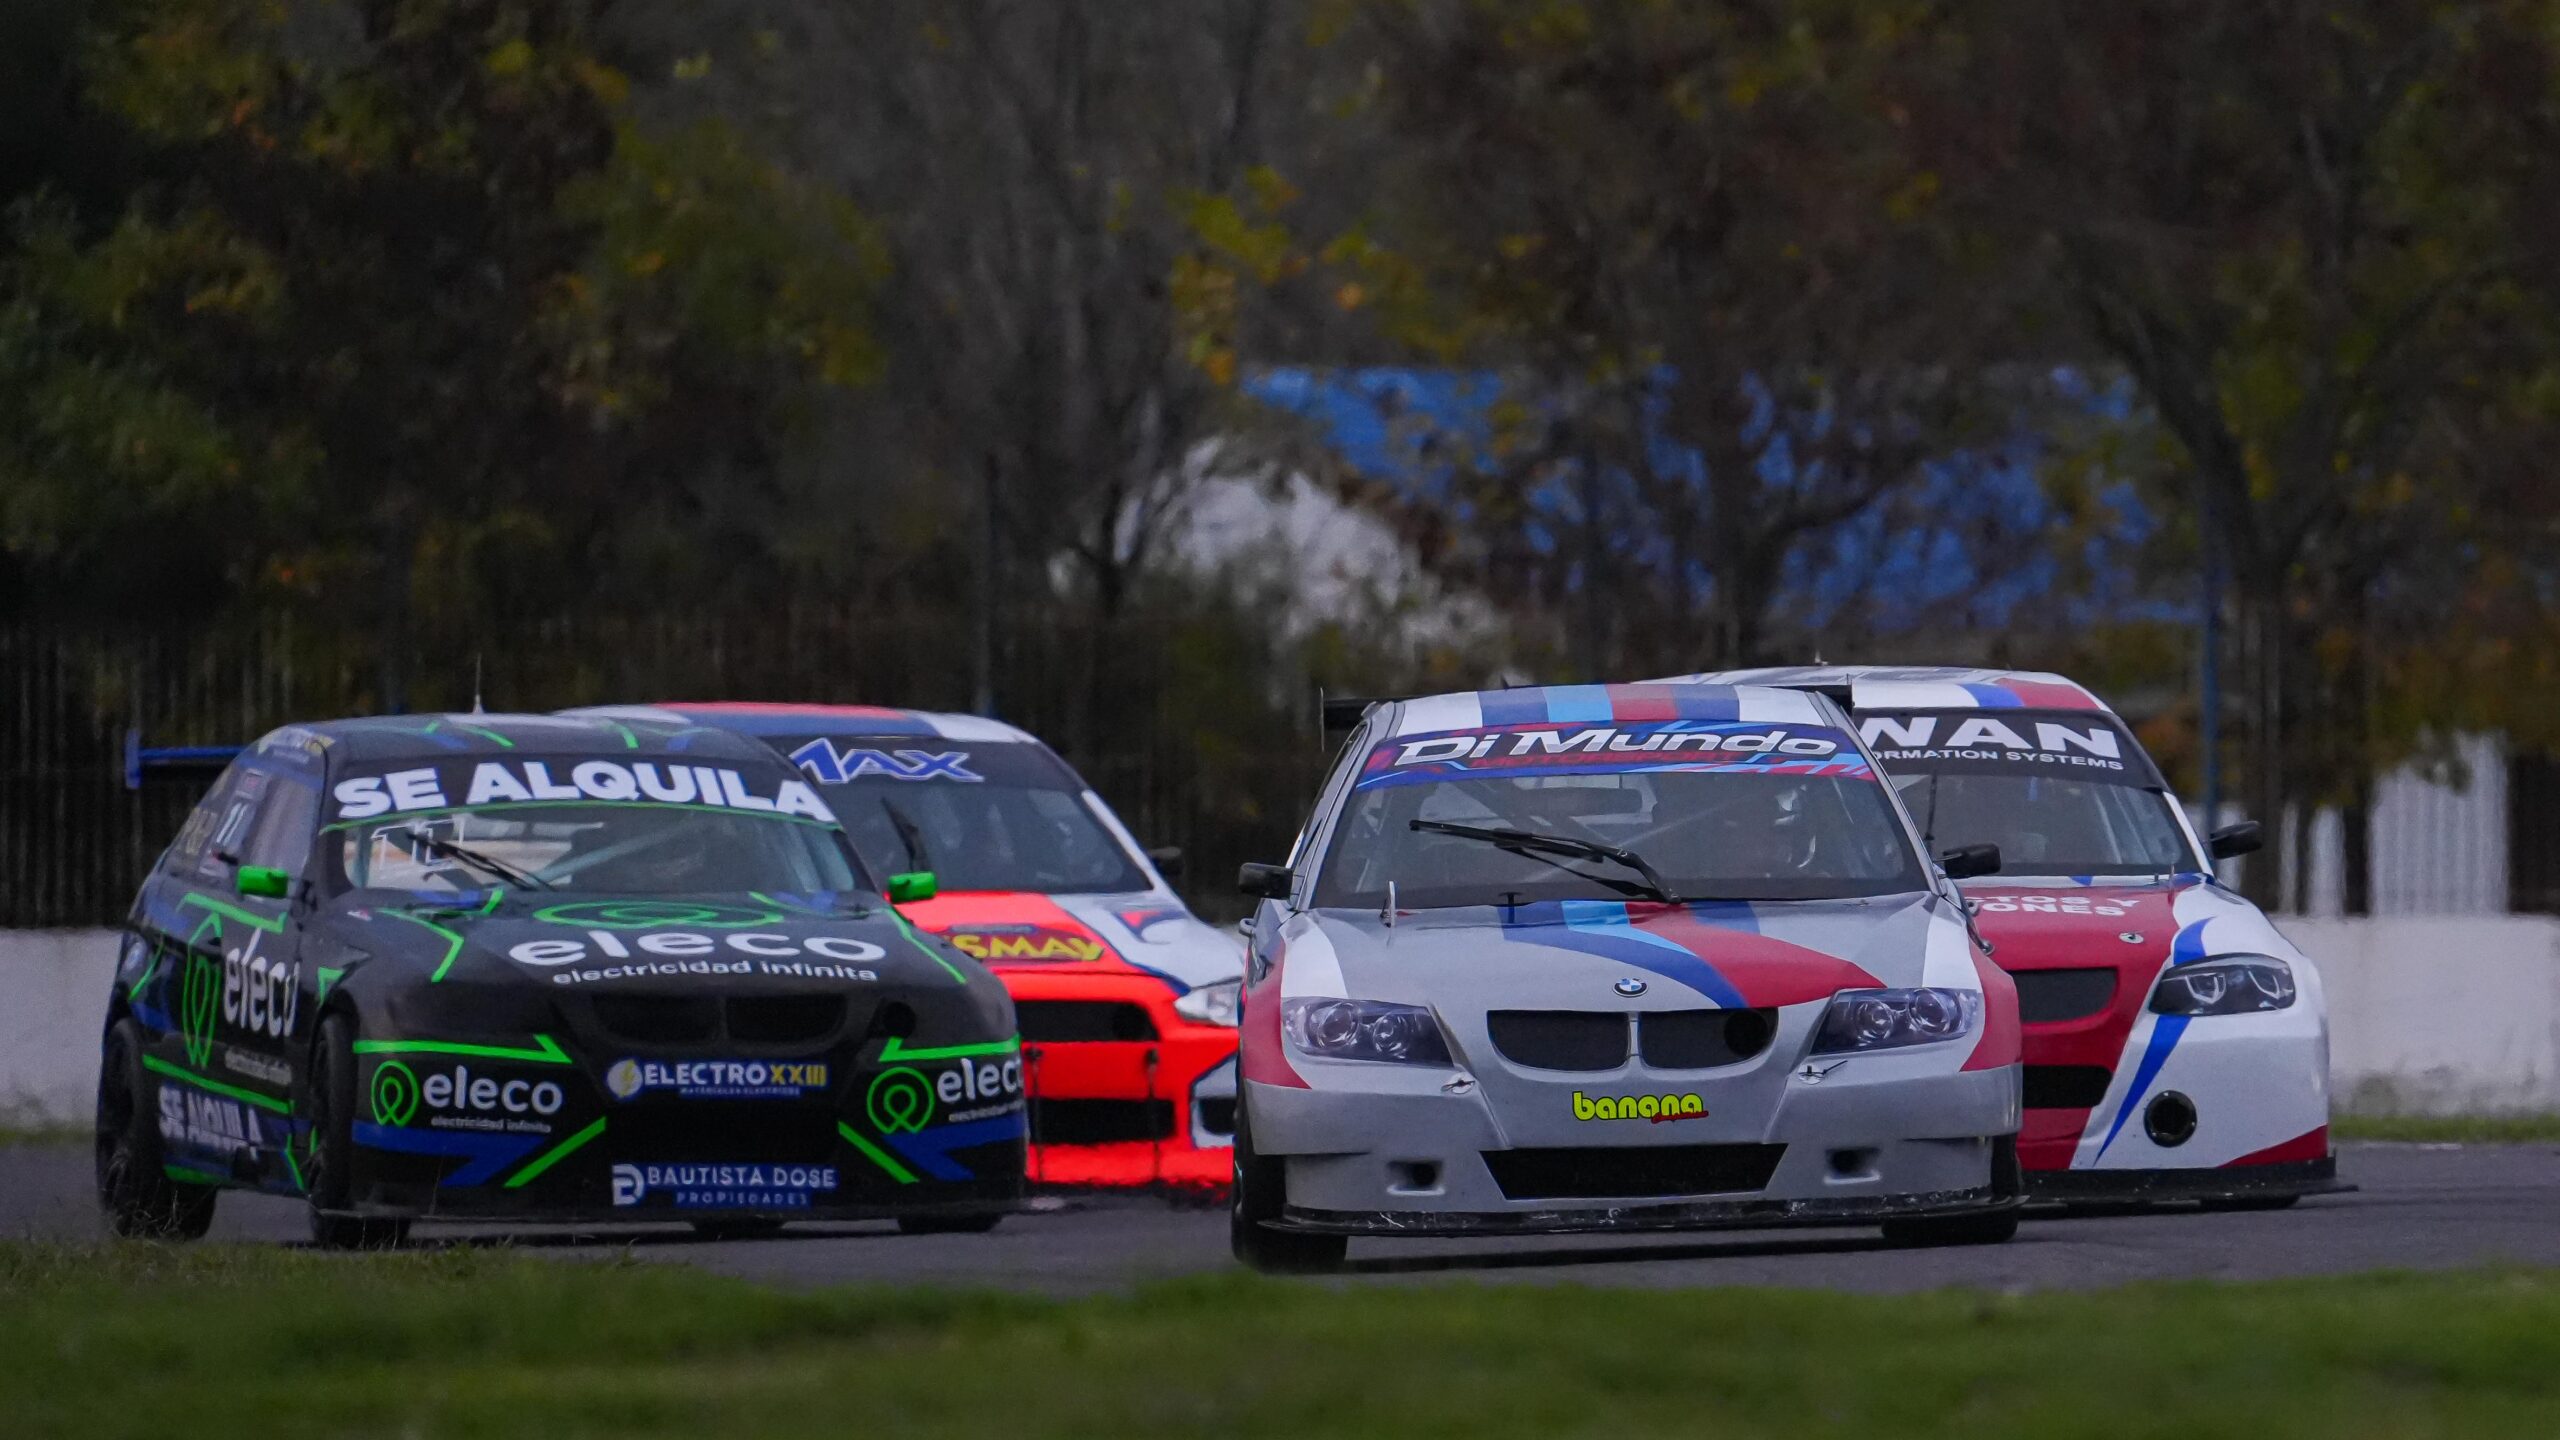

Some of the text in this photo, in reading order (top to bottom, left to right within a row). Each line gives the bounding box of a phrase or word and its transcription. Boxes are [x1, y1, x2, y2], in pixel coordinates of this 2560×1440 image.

[1395, 729, 1837, 766] Di Mundo
[2006, 751, 2124, 771] SYSTEMS
[334, 760, 836, 823] SE ALQUILA
[508, 930, 887, 966] eleco
[943, 934, 1105, 961] SMAY
[552, 960, 879, 985] electricidad infinita
[423, 1064, 563, 1116] eleco
[1572, 1091, 1704, 1121] banana
[647, 1166, 837, 1188] BAUTISTA DOSE
